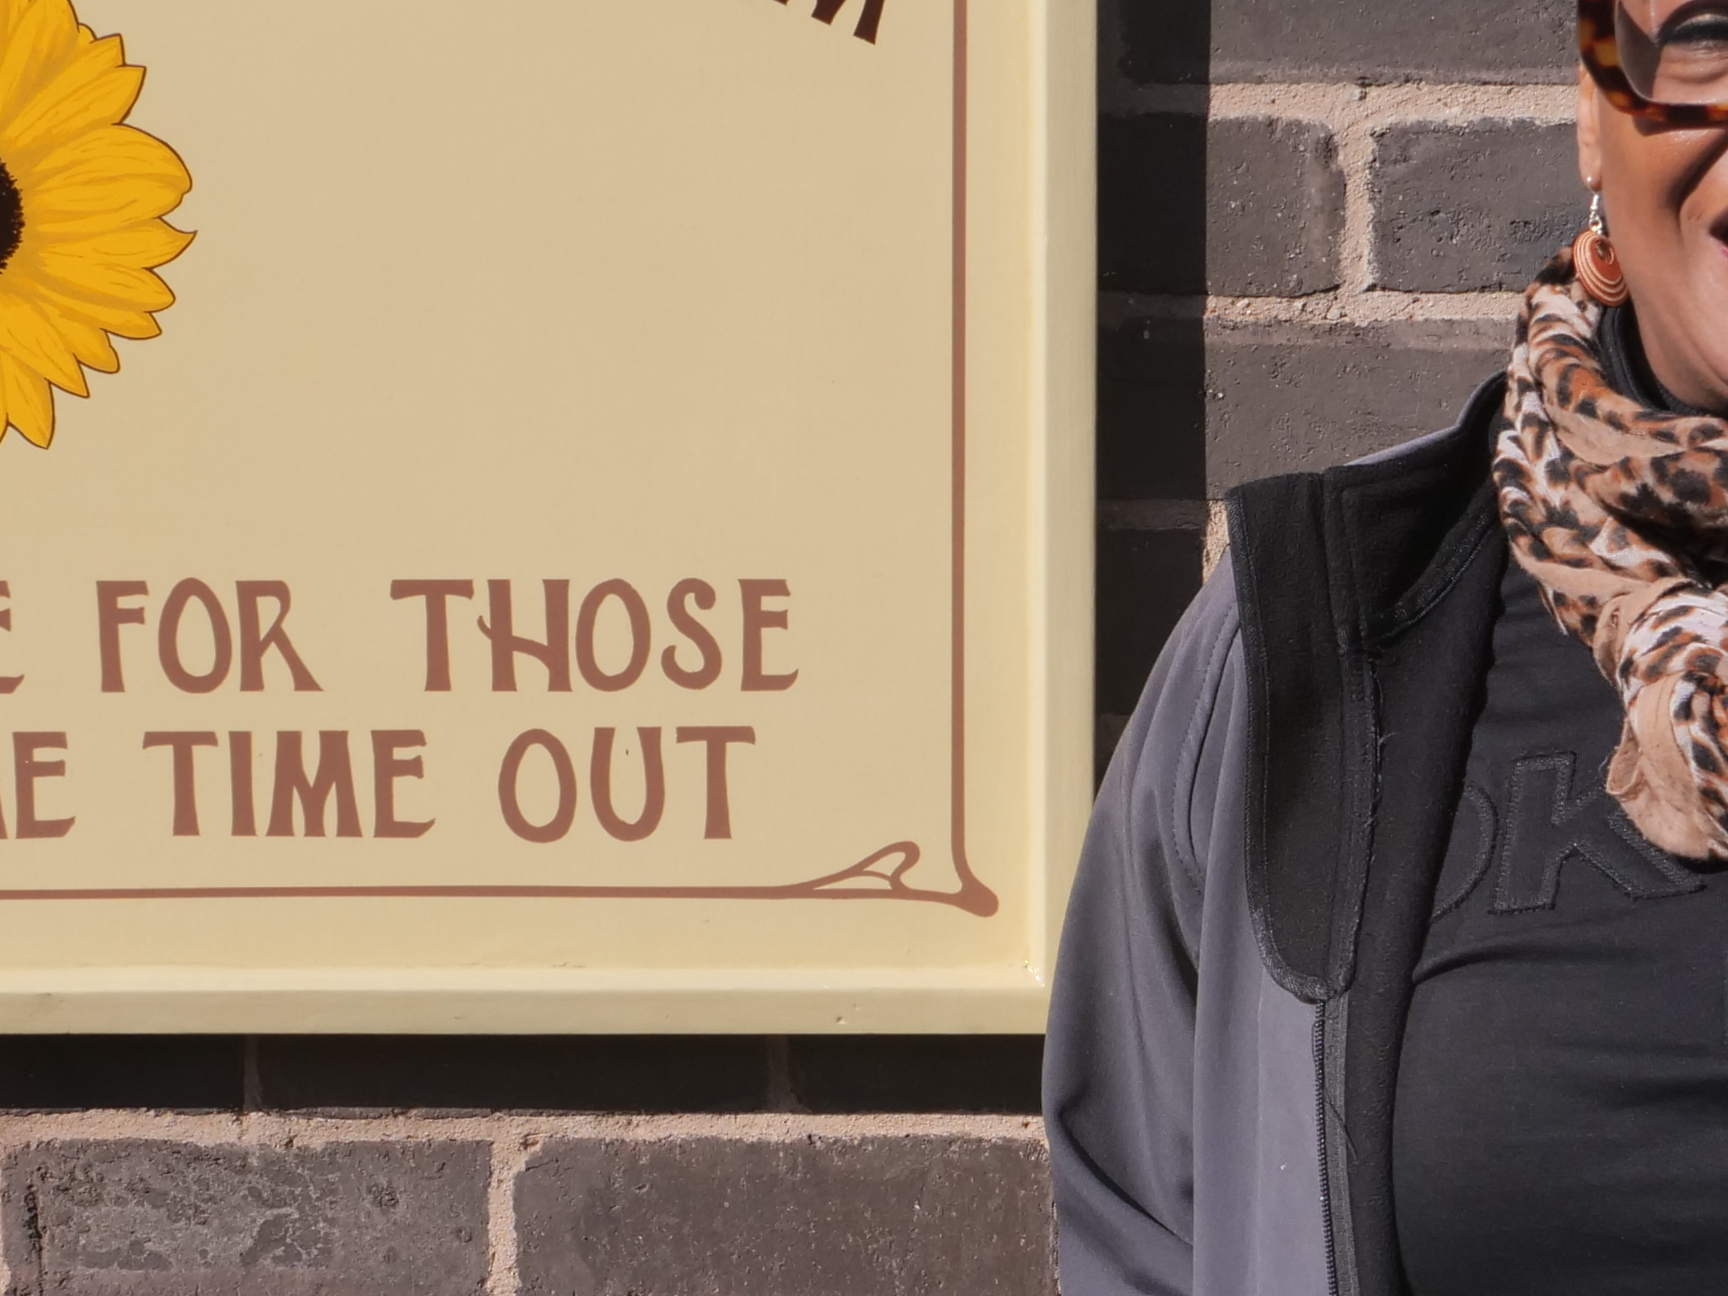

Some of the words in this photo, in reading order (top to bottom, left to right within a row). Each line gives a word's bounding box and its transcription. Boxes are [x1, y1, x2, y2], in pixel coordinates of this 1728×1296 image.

[96, 577, 324, 694] FOR
[390, 577, 799, 693] THOSE
[142, 729, 436, 839] TIME
[497, 725, 756, 844] OUT
